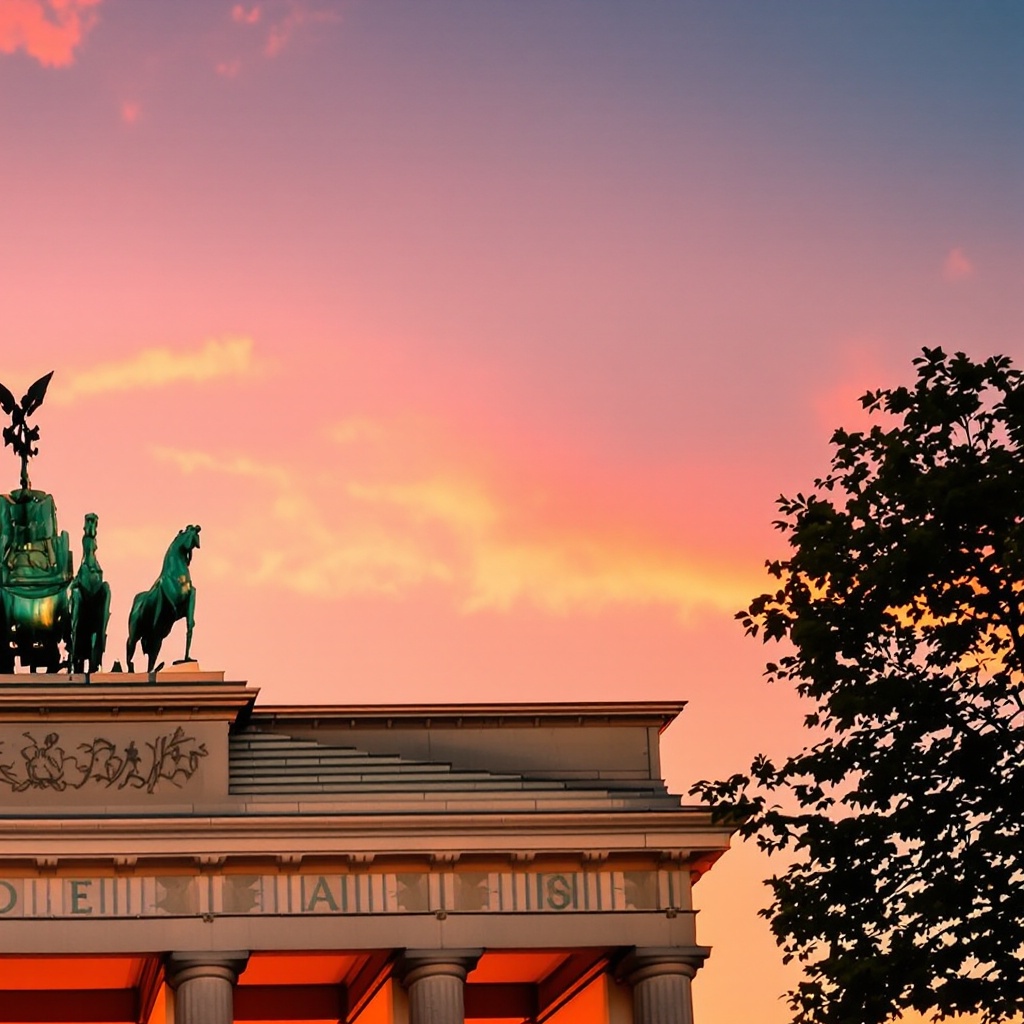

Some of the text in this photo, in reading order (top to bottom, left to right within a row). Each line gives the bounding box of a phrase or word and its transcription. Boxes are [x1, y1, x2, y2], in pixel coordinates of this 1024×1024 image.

[70, 880, 93, 914] E
[307, 876, 340, 911] A
[547, 875, 571, 910] S
